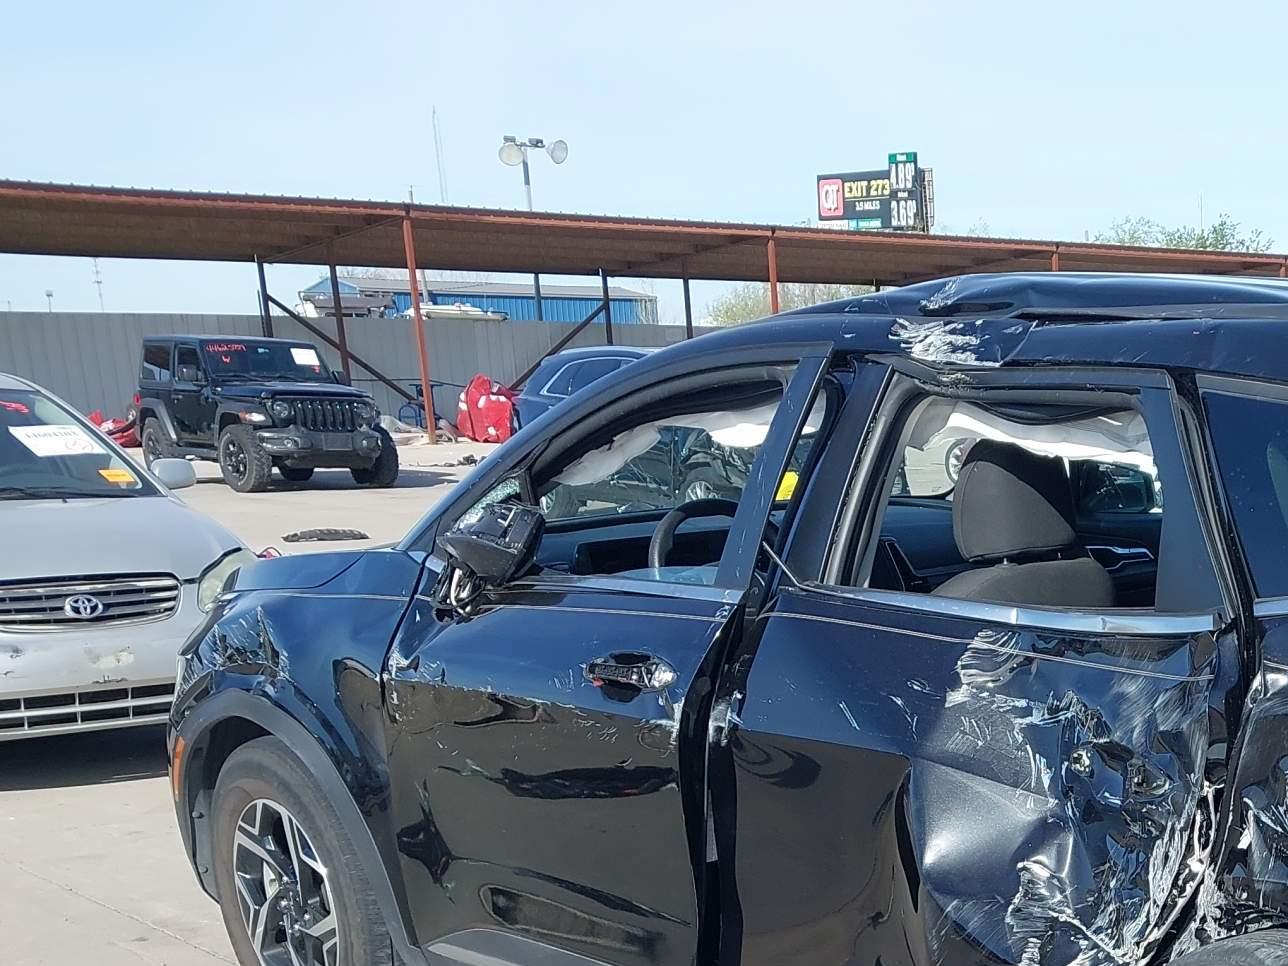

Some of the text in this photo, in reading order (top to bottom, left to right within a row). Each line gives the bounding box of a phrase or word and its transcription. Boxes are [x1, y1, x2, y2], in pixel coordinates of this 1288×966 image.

[823, 185, 839, 210] QT
[844, 179, 890, 198] EXIT 273
[863, 200, 880, 210] MILES
